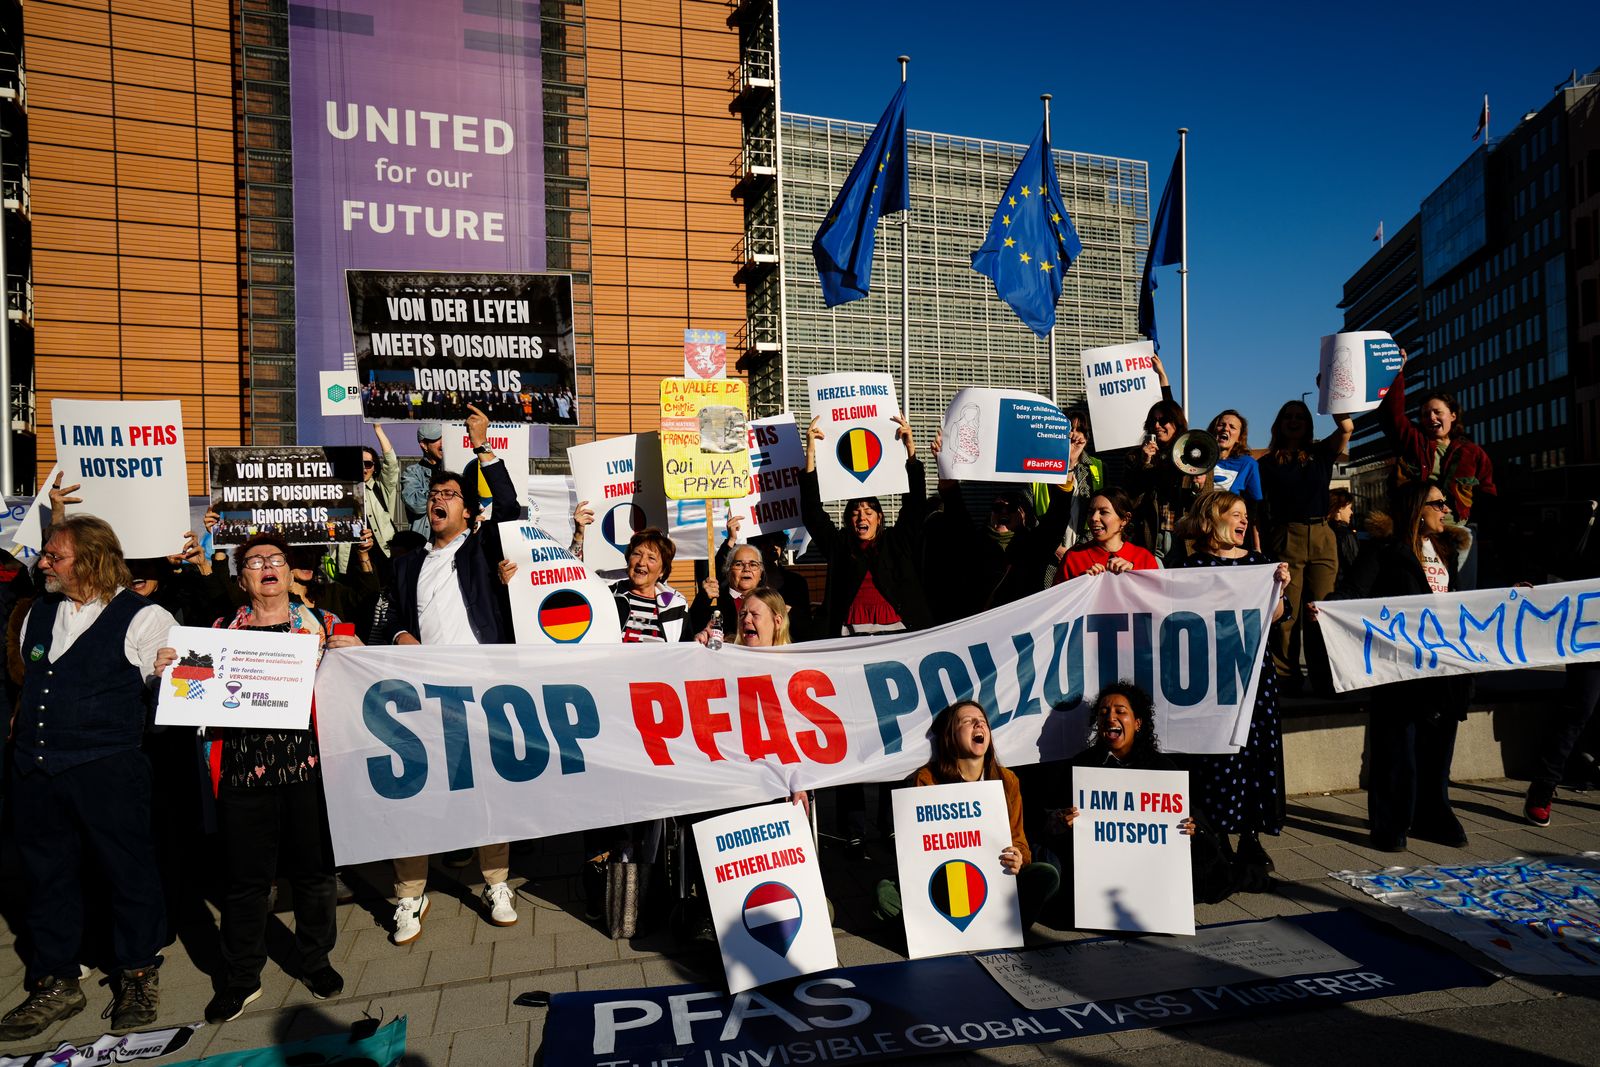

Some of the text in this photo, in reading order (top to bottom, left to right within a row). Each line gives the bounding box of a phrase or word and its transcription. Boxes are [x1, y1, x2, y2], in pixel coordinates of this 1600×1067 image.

[326, 100, 514, 155] UNITED
[375, 157, 473, 189] for our
[343, 200, 505, 243] FUTURE
[386, 297, 530, 324] VON DER LEYEN
[371, 332, 436, 357] MEETS
[440, 334, 543, 359] POISONERS
[1086, 356, 1153, 378] I AM A PFAS
[414, 367, 522, 392] IGNORES US
[664, 381, 679, 394] LA
[725, 383, 740, 394] DE
[1099, 376, 1146, 397] HOTSPOT
[817, 384, 889, 401] HERZELE-RONSE
[832, 404, 878, 422] BELGIUM
[60, 424, 177, 446] I AM A PFAS
[747, 425, 779, 449] FAS
[80, 456, 163, 478] HOTSPOT
[236, 462, 334, 479] VON DER LEYEN
[606, 458, 633, 475] LYON
[711, 459, 735, 475] VA
[1027, 460, 1063, 469] #BanPFAS
[223, 485, 268, 502] MEETS
[272, 484, 343, 501] POISONERS
[604, 480, 642, 498] FRANCE
[252, 507, 328, 524] IGNORES US
[750, 497, 799, 525] HARM
[531, 567, 587, 586] GERMANY
[1362, 591, 1600, 675] MAMME
[251, 700, 289, 708] MANCHING
[362, 608, 1262, 800] STOP PFAS POLLUTION
[916, 801, 982, 823] BRUSSELS
[1079, 789, 1183, 813] I AM A PFAS
[715, 820, 791, 853] DORDRECHT
[922, 830, 982, 852] BELGIUM
[1094, 821, 1168, 845] HOTSPOT
[714, 847, 806, 883] NETHERLANDS
[982, 953, 1026, 965] WHAT
[1064, 941, 1110, 955] PFAS
[995, 962, 1033, 974] PFAS
[593, 977, 872, 1055] PFAS
[905, 1014, 1061, 1049] GLOBAL
[1057, 994, 1193, 1029] MASS
[1190, 971, 1397, 1011] MURDERER
